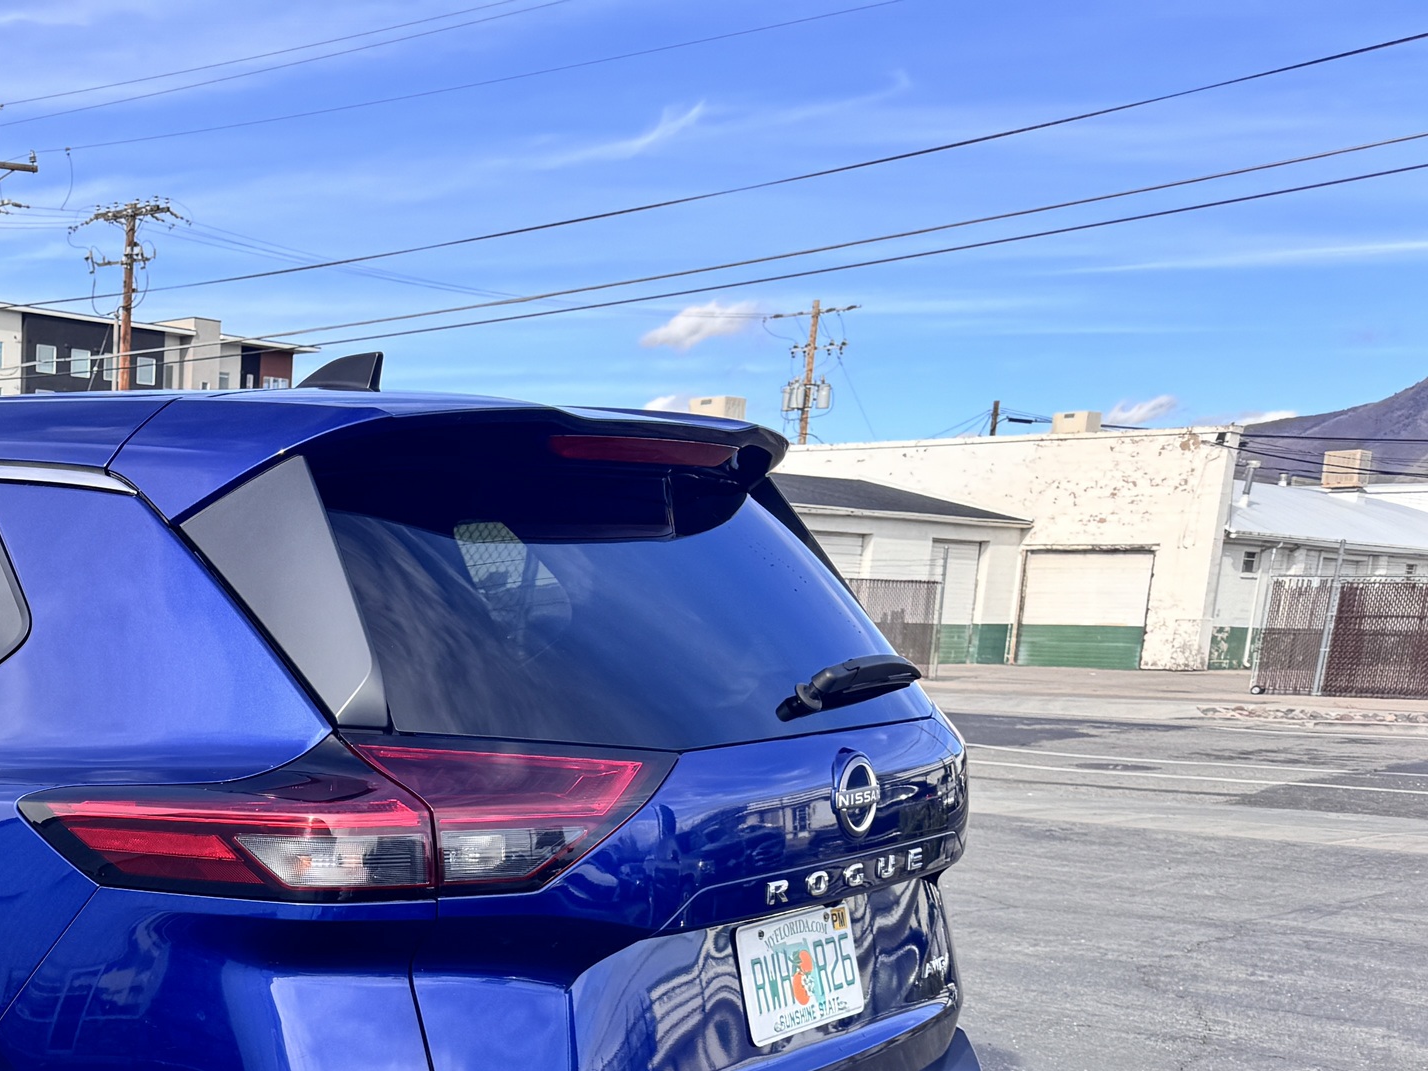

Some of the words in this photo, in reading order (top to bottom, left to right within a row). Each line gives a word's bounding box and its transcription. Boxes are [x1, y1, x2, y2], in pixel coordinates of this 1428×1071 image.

[766, 847, 923, 905] ROGUE
[831, 911, 846, 929] PM
[779, 1004, 817, 1029] SUNSHINE
